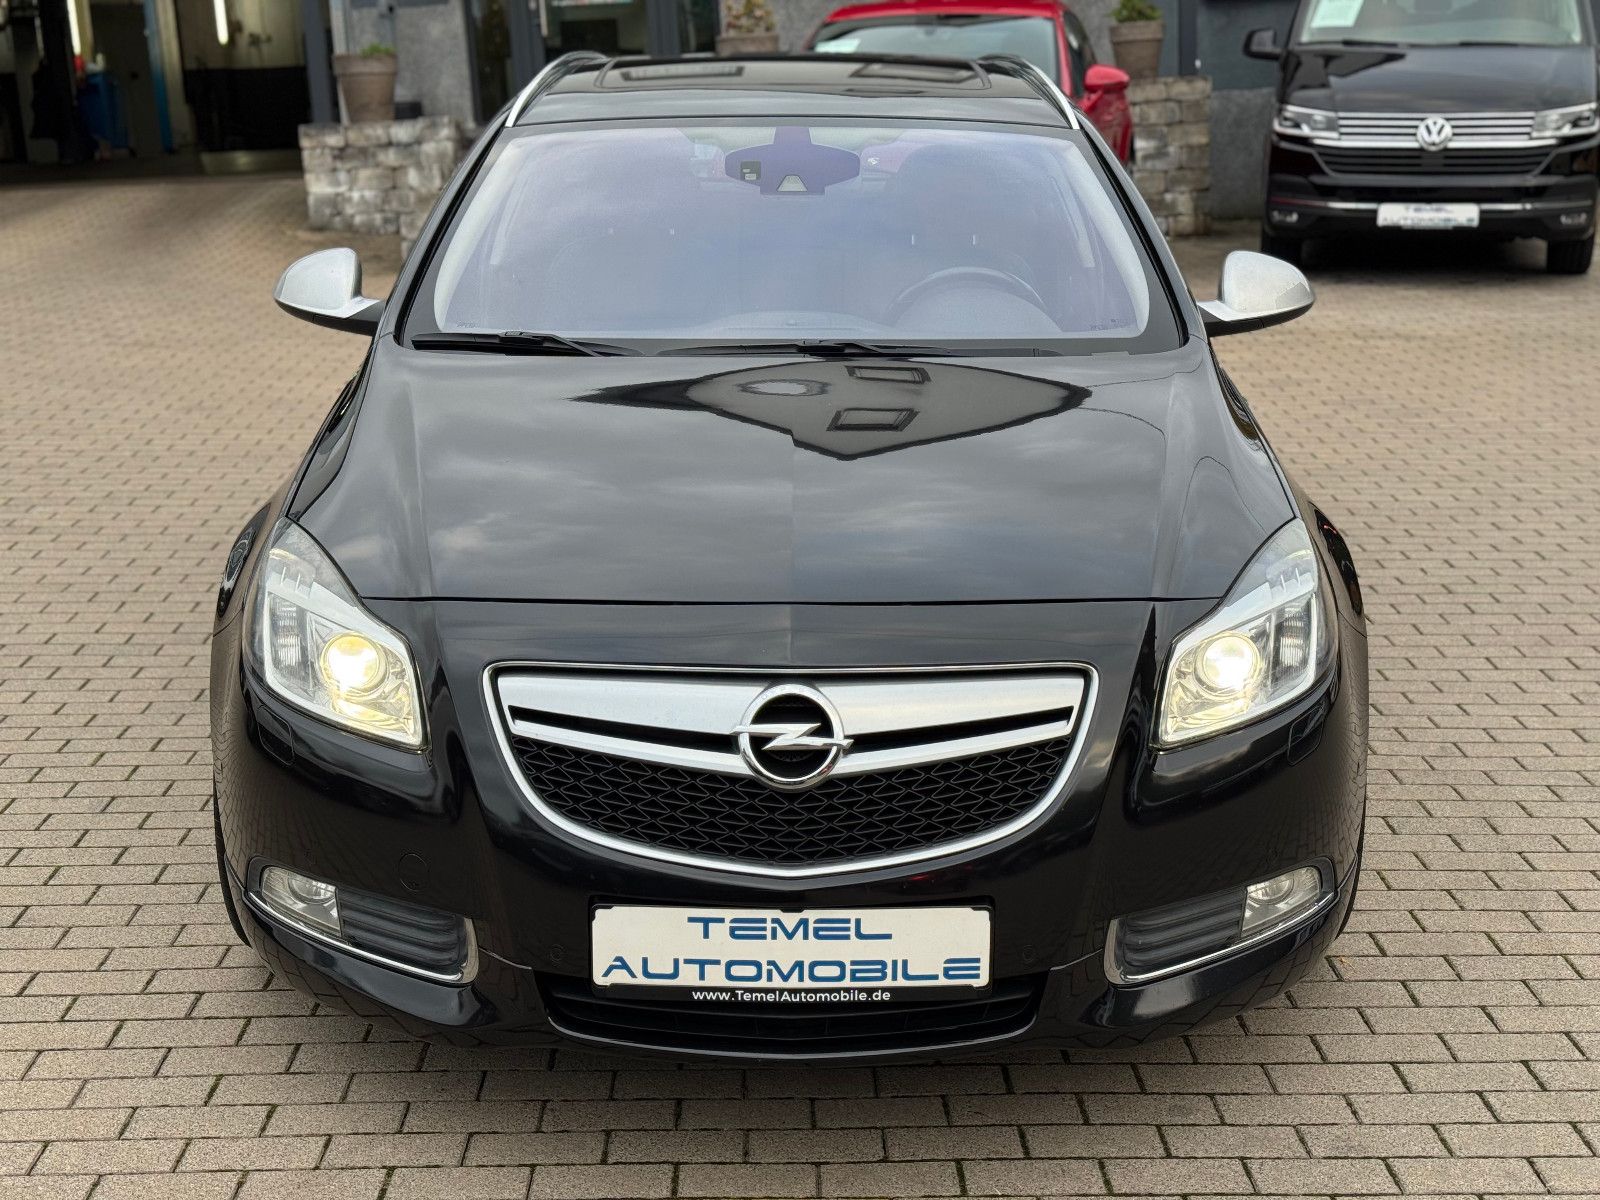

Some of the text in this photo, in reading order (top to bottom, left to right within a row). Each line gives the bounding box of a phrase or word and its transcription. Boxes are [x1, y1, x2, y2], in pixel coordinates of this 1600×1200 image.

[686, 916, 893, 941] TEMEL
[601, 955, 981, 984] AUTOMOBILE
[691, 988, 892, 1003] www.TemelAutomobile.de
